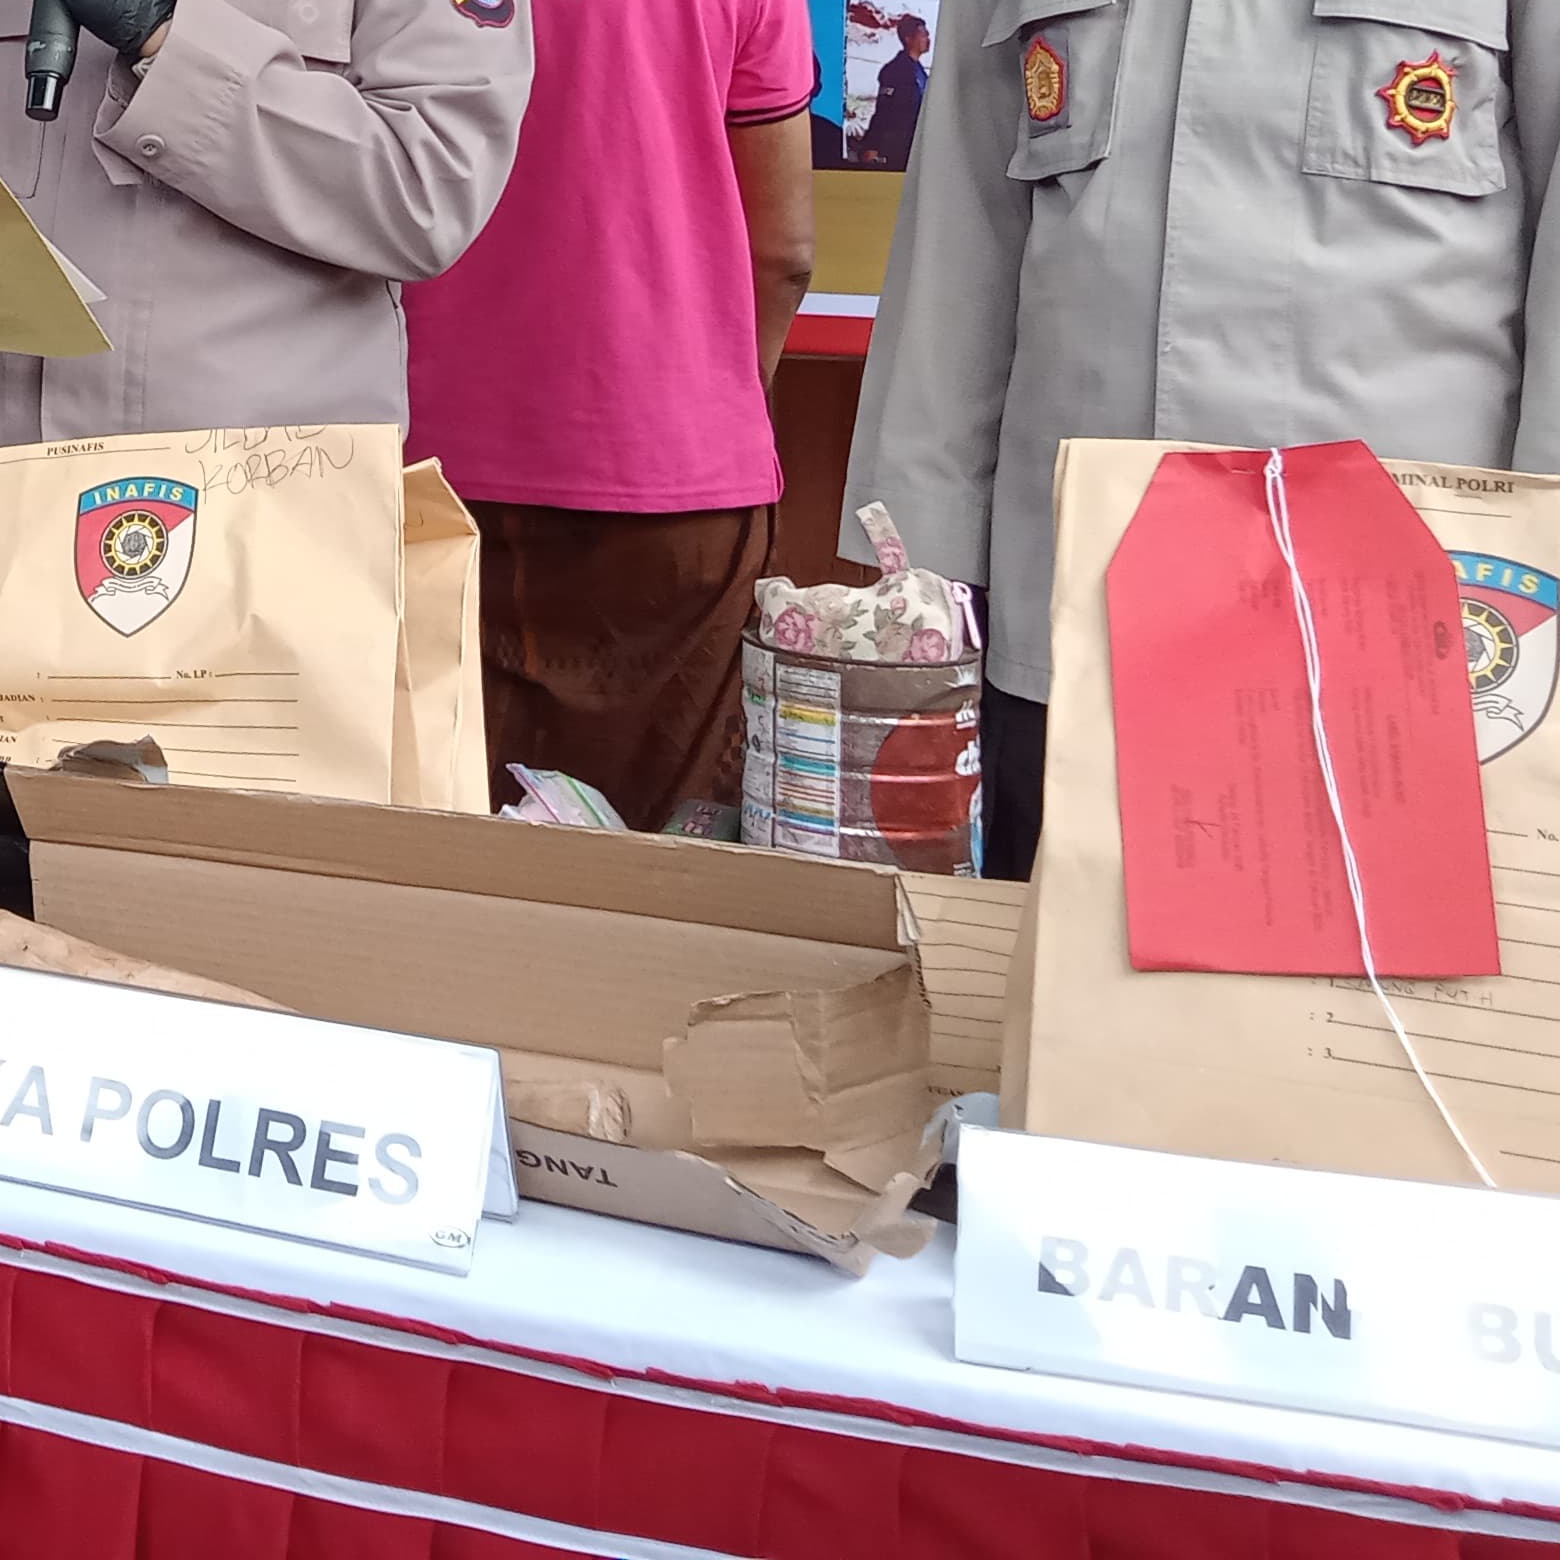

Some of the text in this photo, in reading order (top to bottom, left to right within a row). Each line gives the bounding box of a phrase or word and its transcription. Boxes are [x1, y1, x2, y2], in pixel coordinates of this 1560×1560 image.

[46, 441, 105, 457] PUSINAFIS
[198, 434, 355, 505] KORBAN
[93, 483, 185, 506] INAFIS
[1455, 476, 1516, 494] POLRI
[194, 669, 208, 680] LP
[79, 1075, 424, 1207] POLRES
